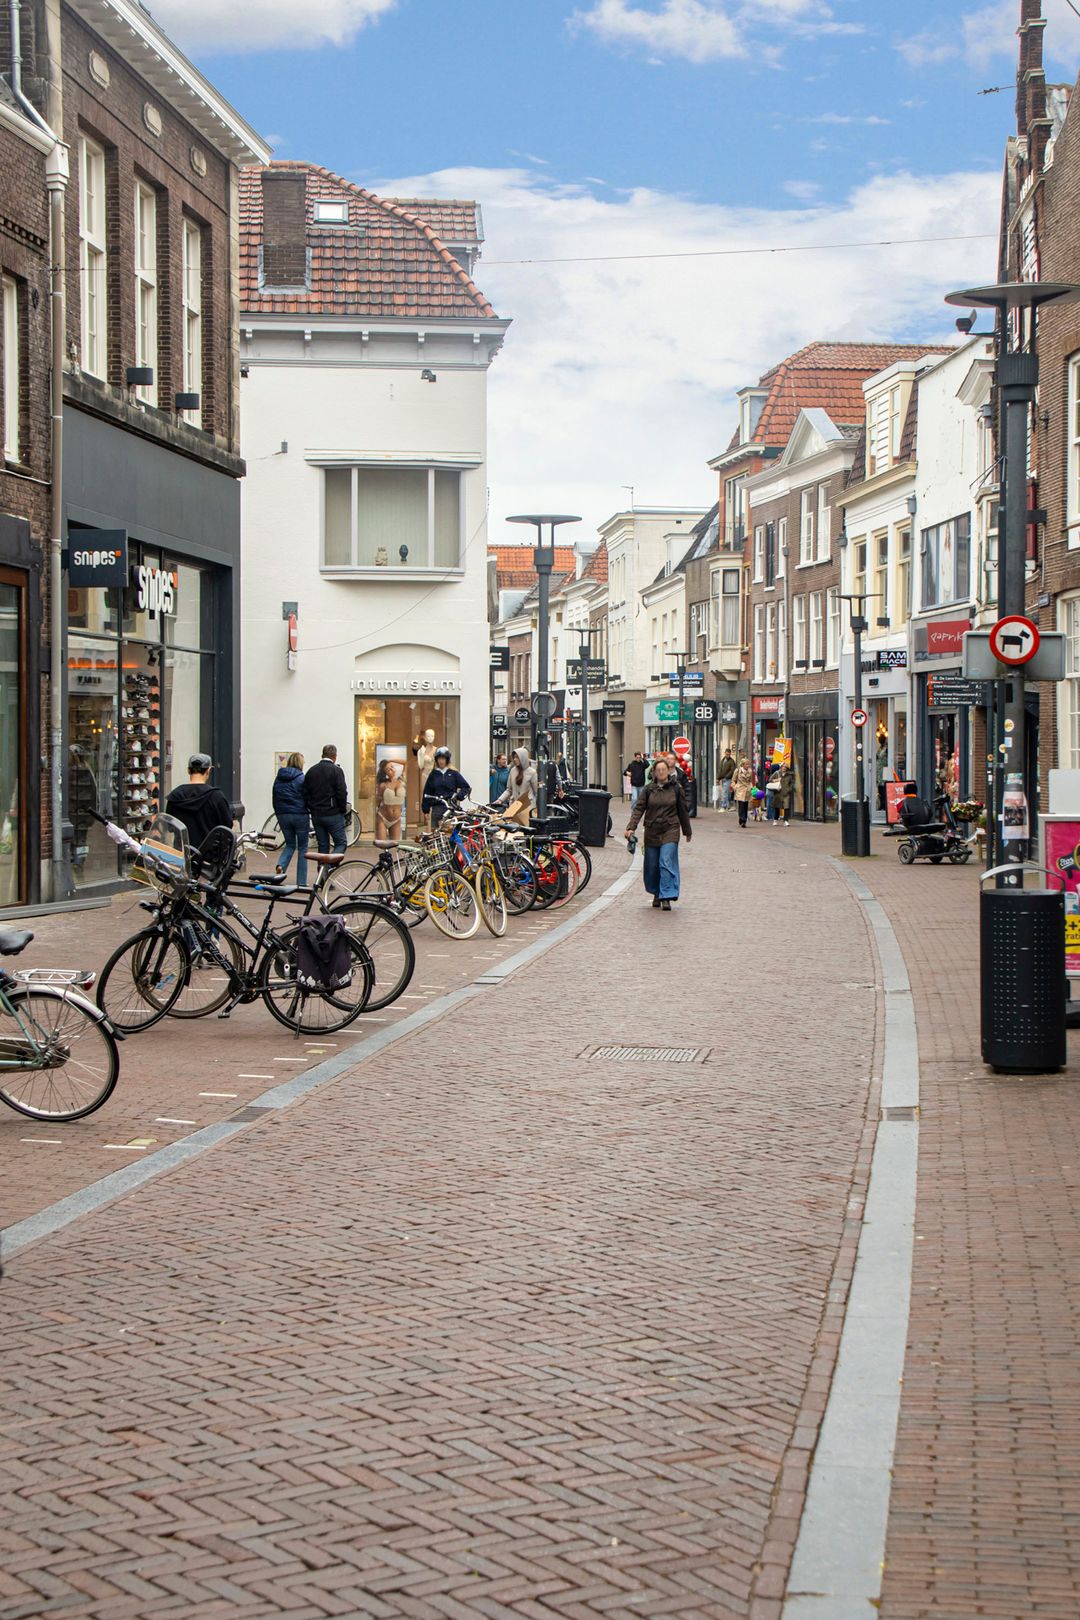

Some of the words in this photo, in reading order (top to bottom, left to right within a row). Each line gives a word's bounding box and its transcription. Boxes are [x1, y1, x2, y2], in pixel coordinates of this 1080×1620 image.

[74, 550, 116, 568] snipes
[138, 565, 174, 620] snipes
[930, 631, 963, 644] paprik
[350, 678, 462, 691] intimissimi
